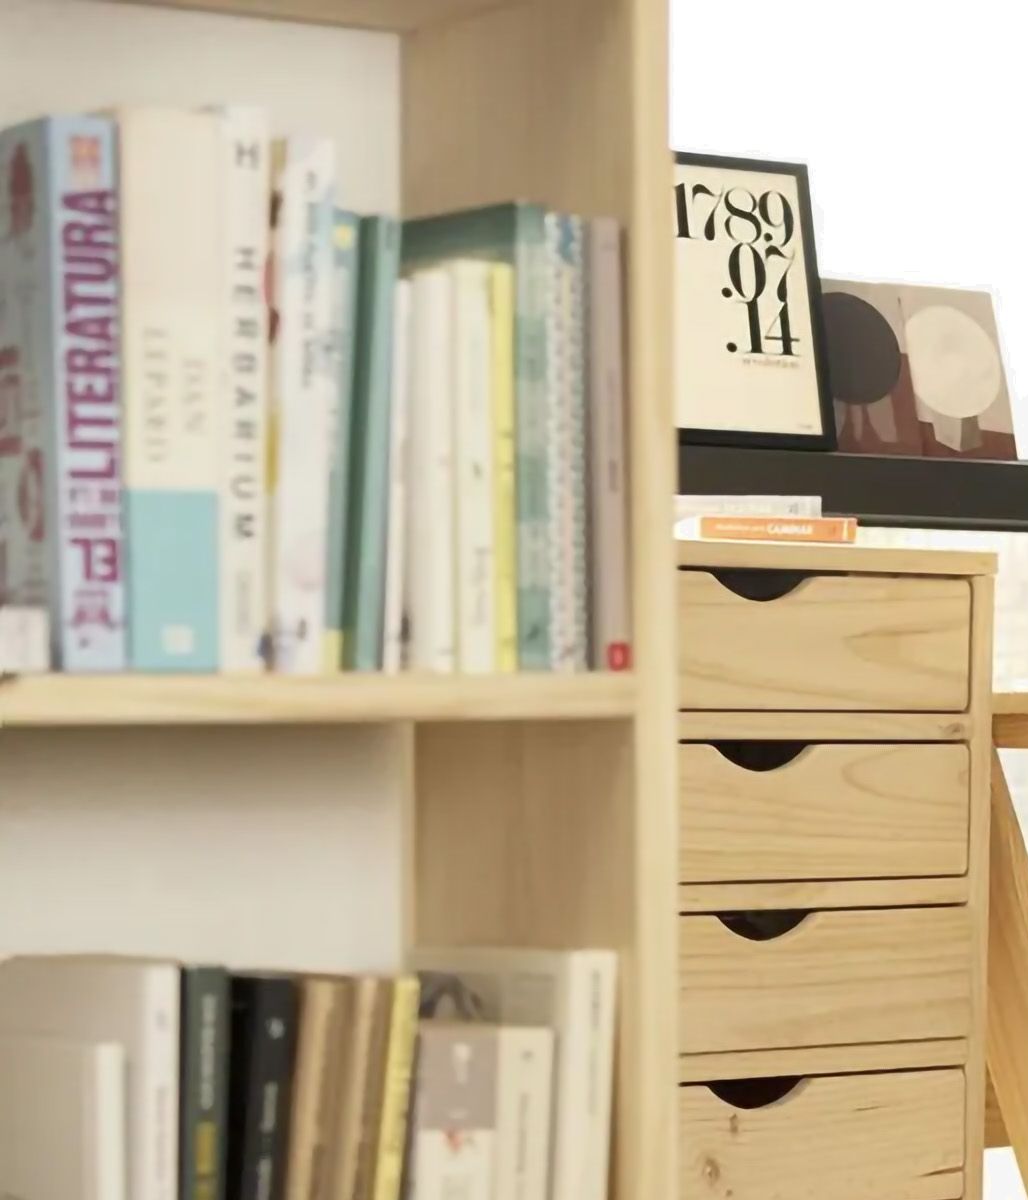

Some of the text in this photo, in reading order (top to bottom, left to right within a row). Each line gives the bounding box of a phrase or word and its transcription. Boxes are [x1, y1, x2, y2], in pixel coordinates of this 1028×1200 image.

[61, 190, 119, 479] LITERATURA
[675, 182, 795, 248] 1789
[231, 247, 259, 540] HERBARIUM
